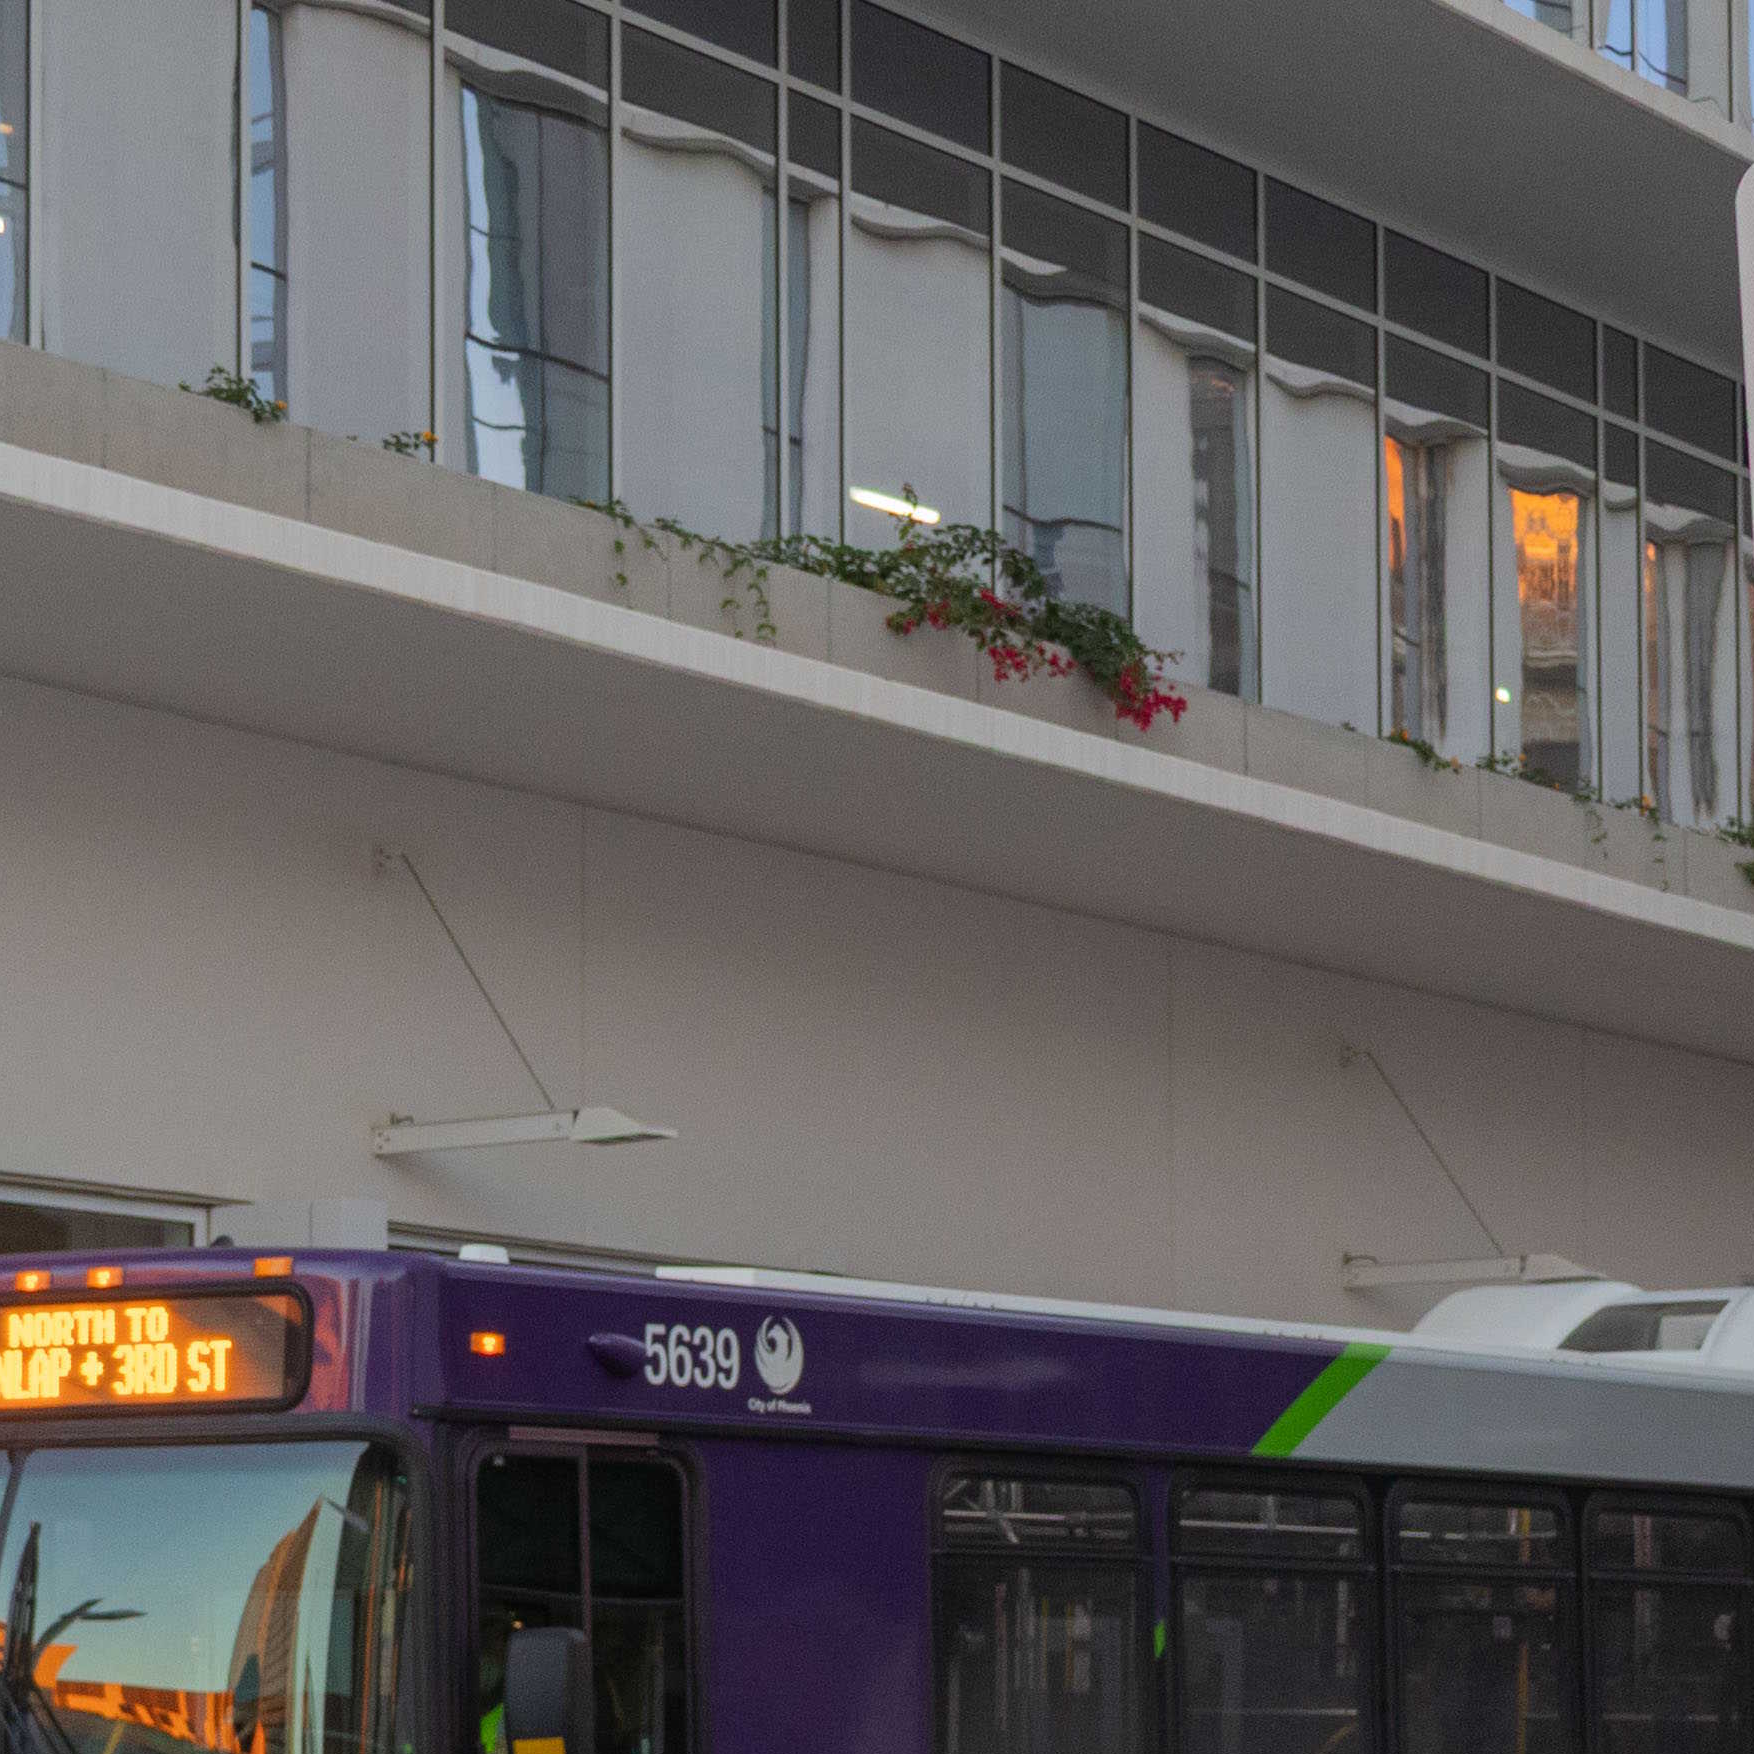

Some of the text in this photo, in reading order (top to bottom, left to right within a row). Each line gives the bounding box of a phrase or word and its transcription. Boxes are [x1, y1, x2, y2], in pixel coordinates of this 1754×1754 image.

[8, 1306, 169, 1348] NORTH TO
[80, 1351, 104, 1386] +
[112, 1342, 178, 1395] 3RD
[187, 1338, 233, 1393] ST
[644, 1322, 741, 1390] 5639
